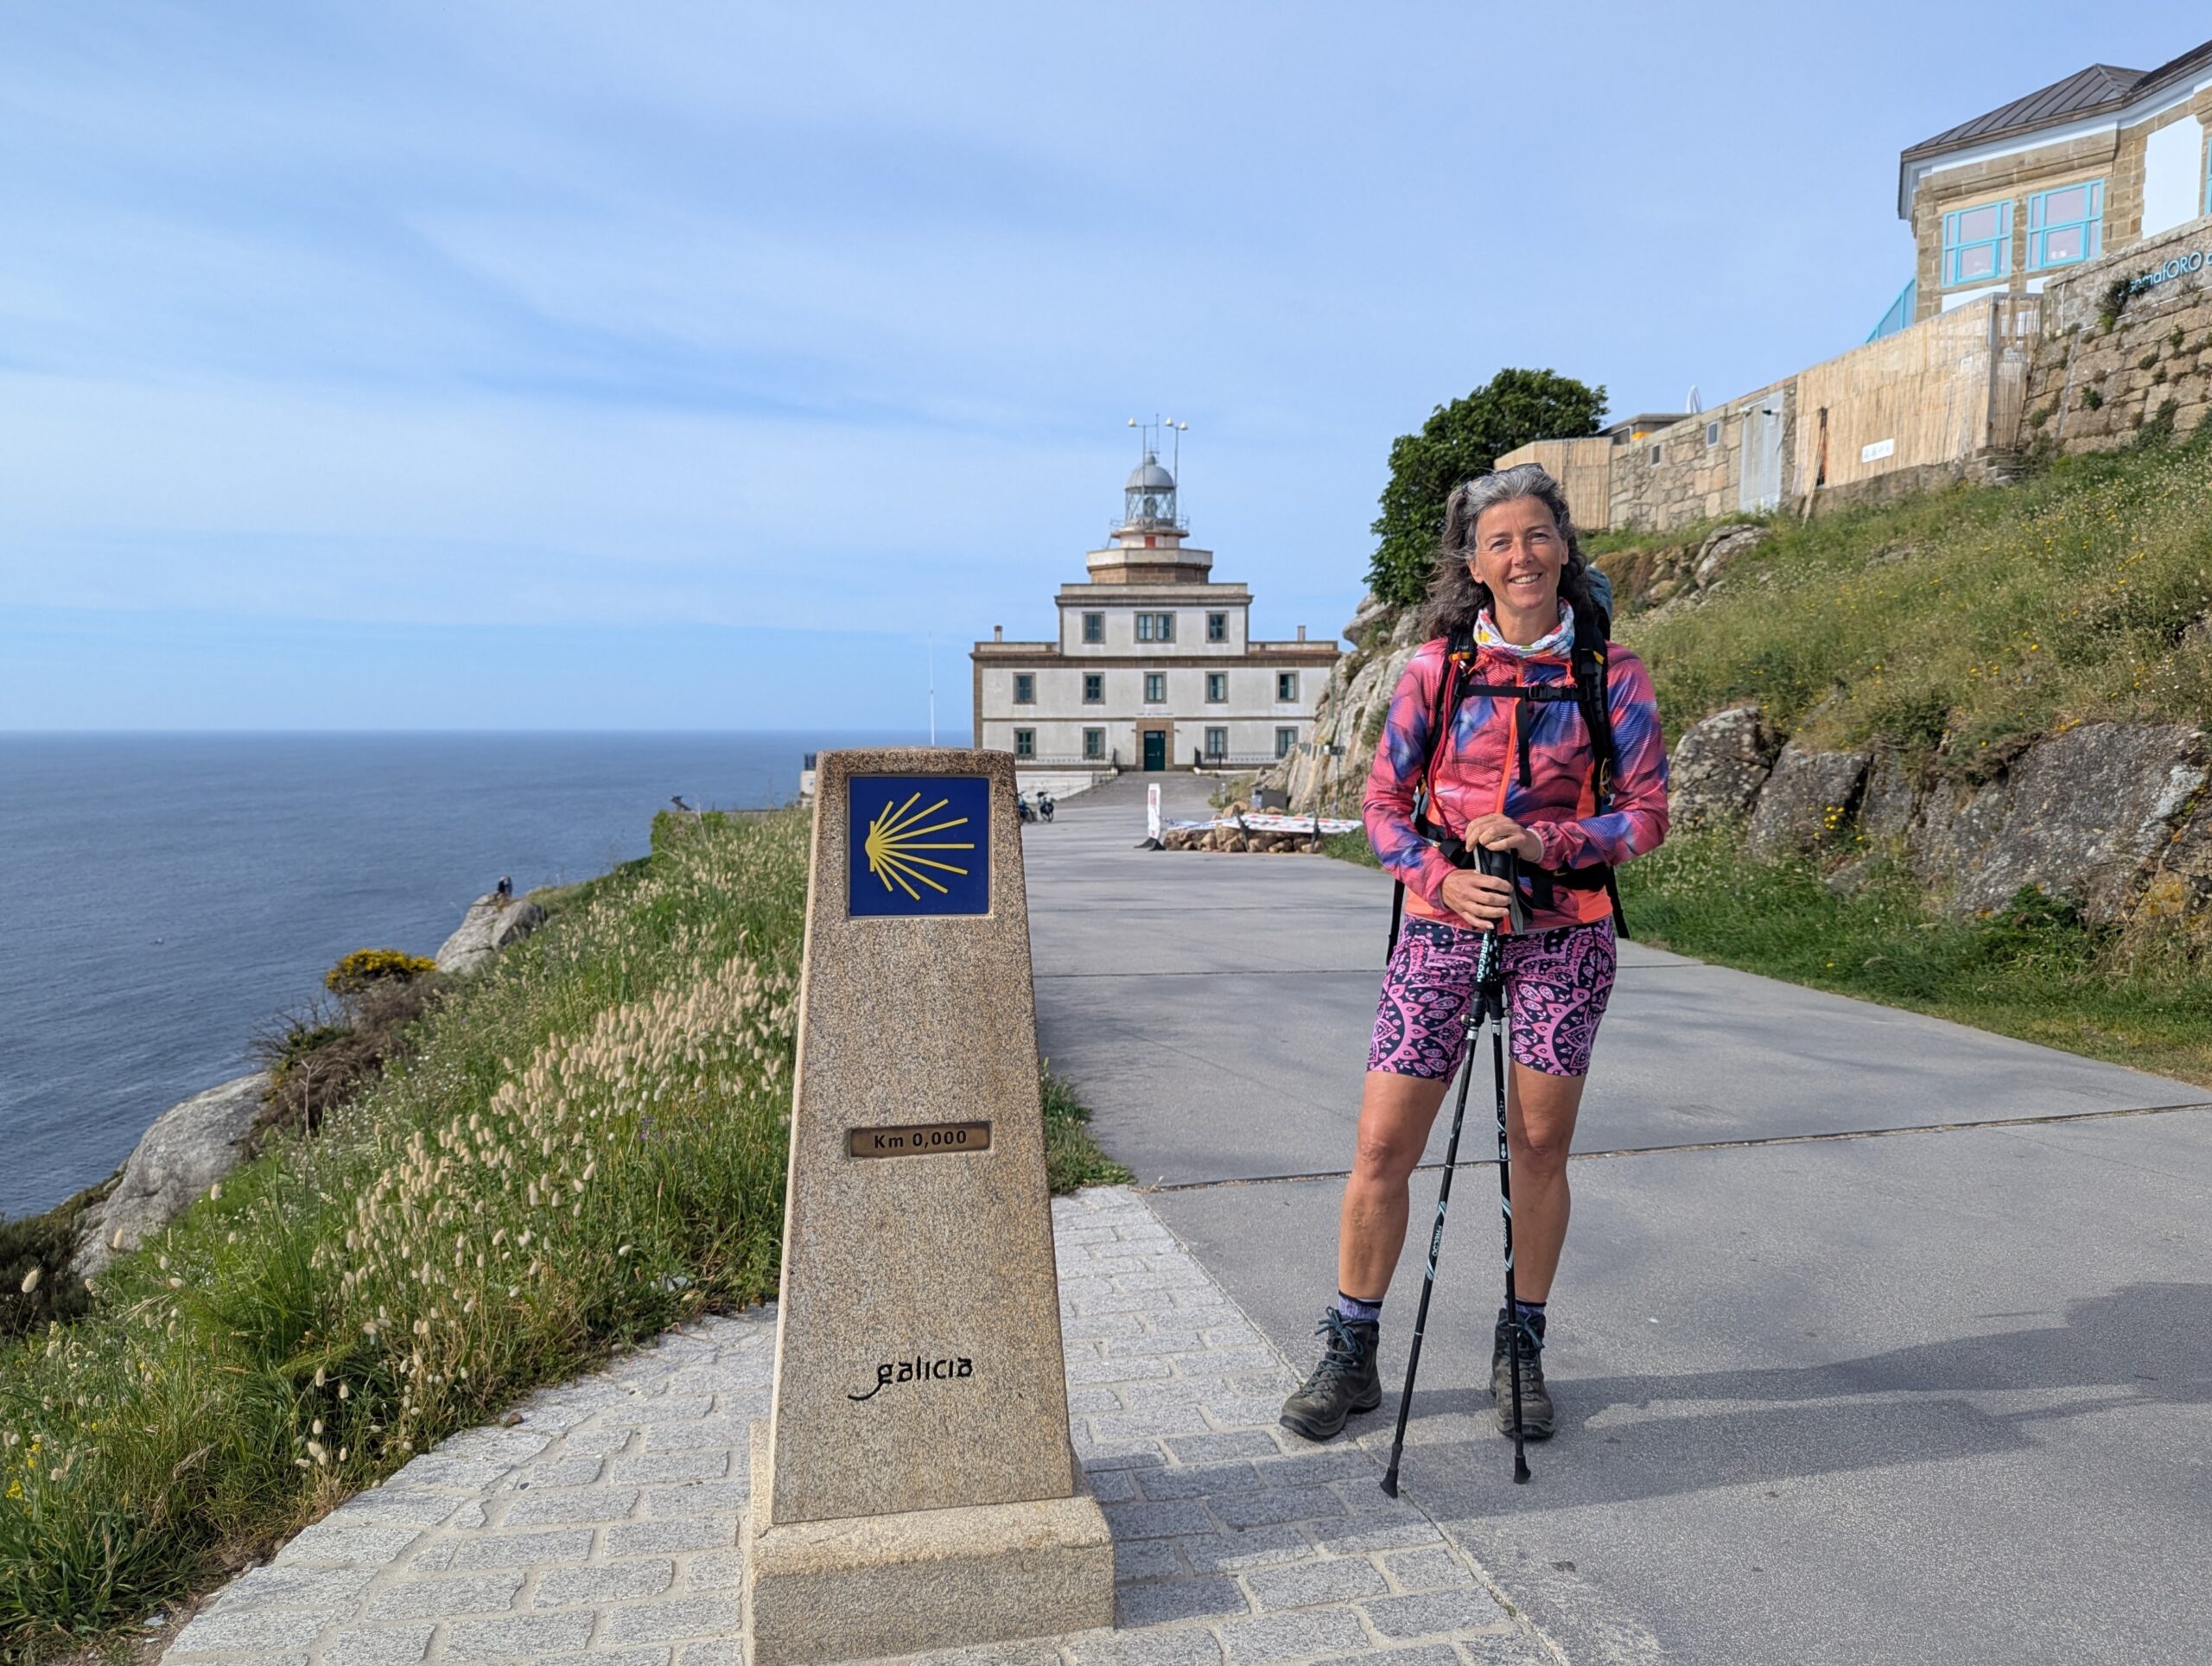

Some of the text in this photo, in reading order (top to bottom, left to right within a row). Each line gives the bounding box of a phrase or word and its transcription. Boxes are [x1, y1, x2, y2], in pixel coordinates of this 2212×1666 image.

[874, 1130, 967, 1149] Km 0,000
[848, 1356, 974, 1401] galicia
